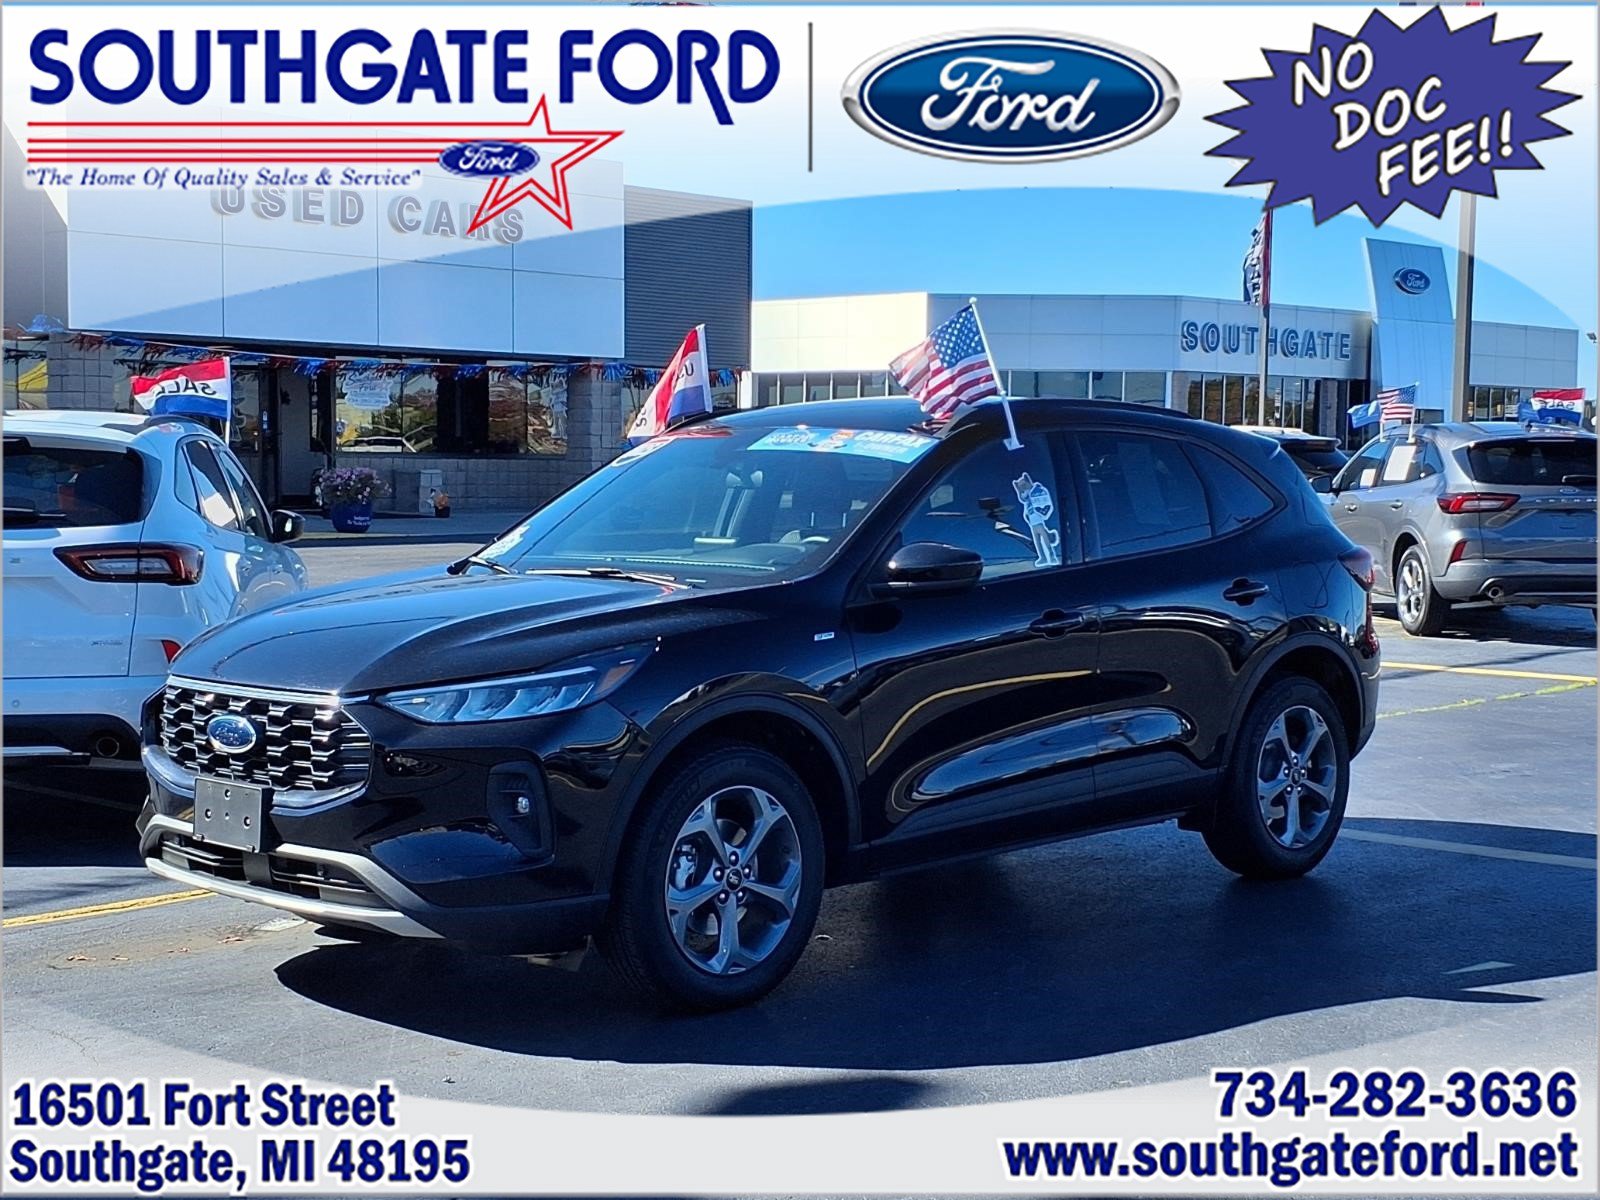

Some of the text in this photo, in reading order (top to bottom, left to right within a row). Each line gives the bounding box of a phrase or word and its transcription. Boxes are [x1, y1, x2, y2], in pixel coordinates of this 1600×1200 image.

[211, 184, 524, 244] USED CARS
[1182, 320, 1351, 361] SOUTHGATE
[853, 430, 931, 448] CARFAX
